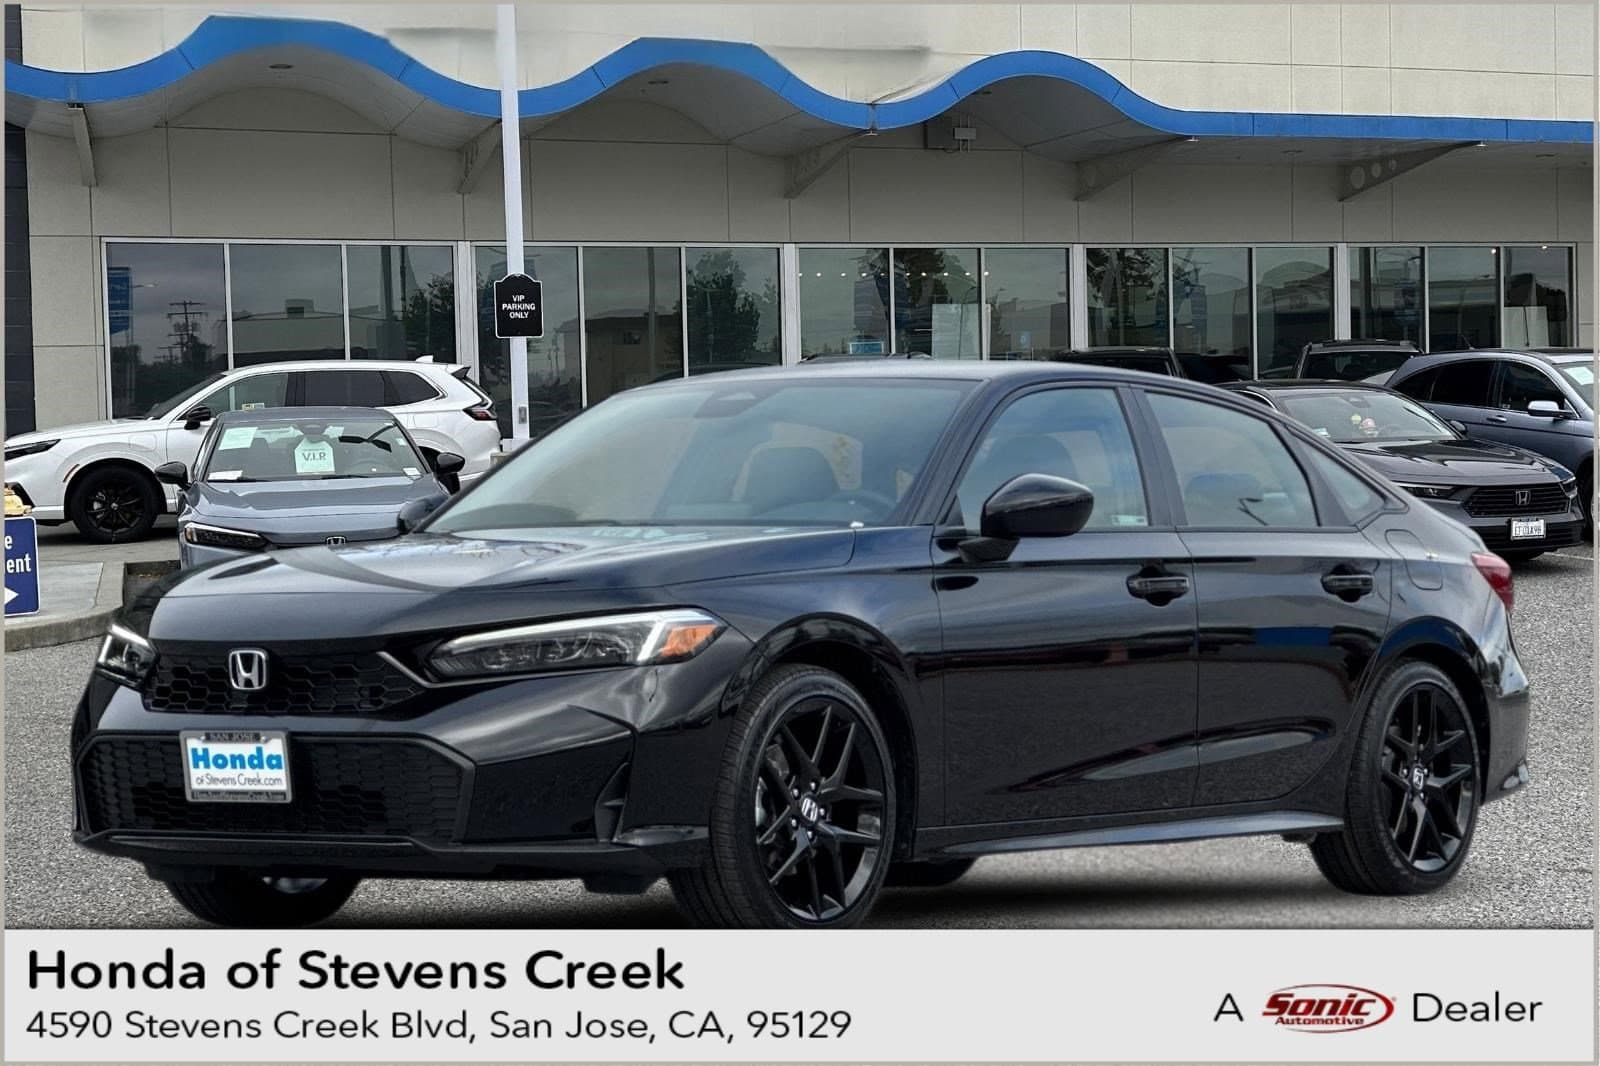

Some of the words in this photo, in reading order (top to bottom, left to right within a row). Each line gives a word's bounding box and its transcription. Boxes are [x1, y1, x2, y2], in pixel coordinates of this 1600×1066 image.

[512, 294, 525, 302] VIP
[509, 311, 529, 319] ONLY
[191, 746, 283, 770] Honda
